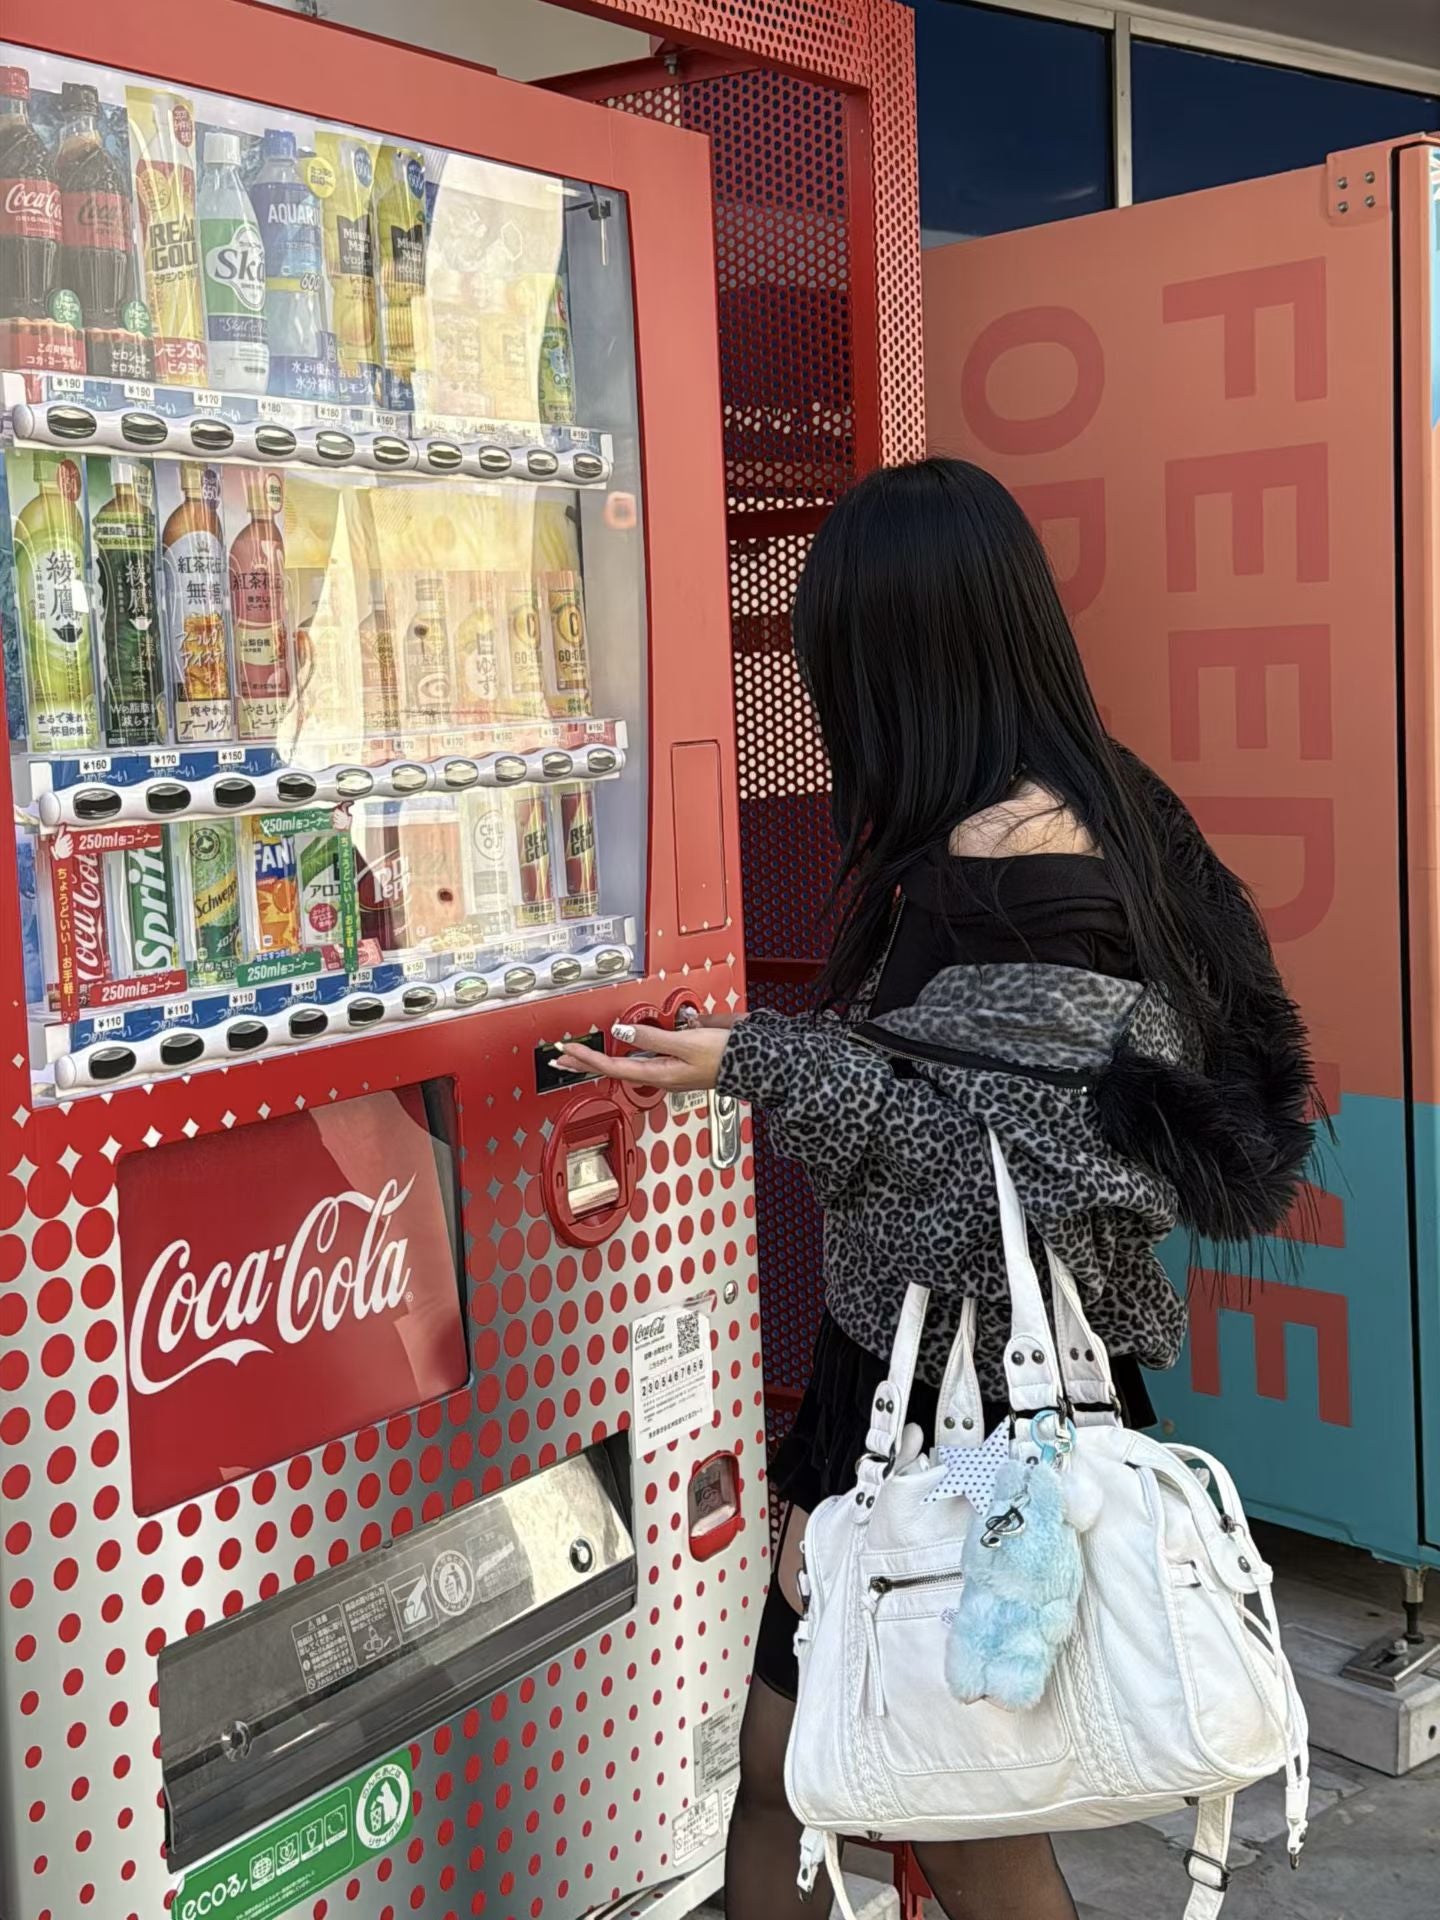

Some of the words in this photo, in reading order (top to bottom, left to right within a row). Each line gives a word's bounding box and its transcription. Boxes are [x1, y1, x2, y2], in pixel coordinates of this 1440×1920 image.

[57, 376, 82, 390] ¥190
[128, 384, 152, 398] ¥190
[1162, 256, 1336, 944] FEED
[83, 758, 107, 772] ¥160
[153, 753, 177, 766] ¥170
[79, 826, 160, 850] 250ml缶コーナー
[246, 958, 317, 982] 250ml缶コーナー
[102, 978, 182, 1003] 250ml缶コーナー
[294, 979, 316, 992] ¥110
[231, 991, 254, 1005] ¥110
[167, 1002, 190, 1017] ¥110
[98, 1014, 122, 1029] ¥110
[129, 1173, 418, 1396] Coca-Cola
[634, 1314, 666, 1345] Coca-Cola
